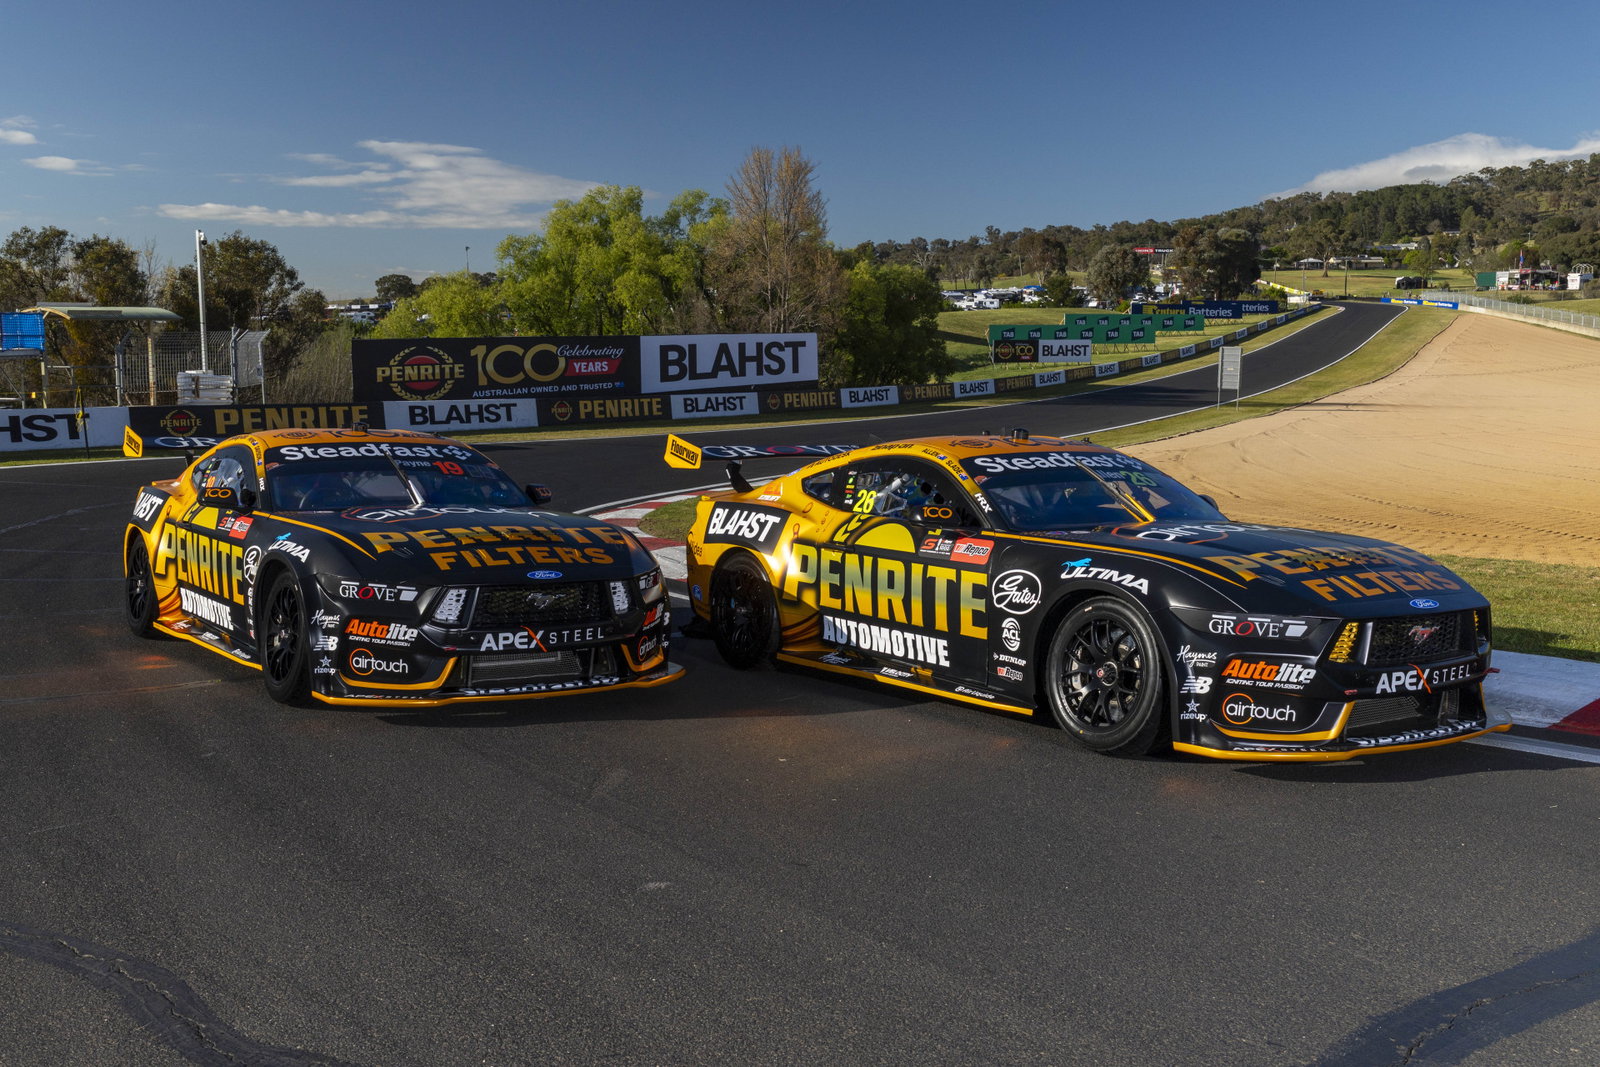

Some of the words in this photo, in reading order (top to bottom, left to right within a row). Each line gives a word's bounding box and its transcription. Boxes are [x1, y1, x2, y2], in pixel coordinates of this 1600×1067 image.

[1188, 306, 1232, 316] Batteries
[556, 344, 625, 359] Celebrating
[1015, 346, 1034, 356] 100
[1042, 345, 1089, 356] BLAHST
[470, 343, 566, 386] 100
[572, 361, 608, 373] YEARS
[659, 340, 806, 383] BLAHST
[1098, 364, 1116, 374] BLAHST
[376, 364, 465, 382] PENRITE
[1040, 372, 1061, 384] BLAHST
[472, 387, 528, 398] AUSTRALIAN
[530, 385, 560, 393] OWNED
[578, 382, 613, 390] TRUSTED
[914, 384, 952, 399] PENRITE
[960, 382, 989, 394] BLAHST
[1006, 376, 1033, 389] PENRITE
[784, 392, 836, 408] PENRITE
[849, 388, 890, 403] BLAHST
[408, 402, 517, 425] BLAHST
[579, 398, 662, 419] PENRITE
[683, 396, 746, 414] BLAHST
[0, 413, 90, 442] HST
[160, 418, 202, 427] PENRITE
[214, 406, 368, 434] PENRITE
[280, 444, 444, 461] Steadfast
[671, 439, 699, 464] Floorway
[922, 448, 940, 458] ALLEN
[396, 460, 432, 468] Payne
[433, 461, 464, 475] 19
[945, 460, 964, 475] SLADE
[974, 452, 1124, 473] Steadfast
[1096, 470, 1126, 480] llen
[1120, 470, 1158, 486] 26
[205, 488, 232, 498] 100
[853, 490, 877, 513] 26
[974, 493, 993, 513] HRX
[923, 507, 953, 519] 100
[708, 507, 781, 542] BLAHST
[360, 526, 628, 553] PENRITE
[430, 545, 614, 570] FILTERS
[964, 543, 989, 555] Repco
[155, 522, 244, 606] PENRITE
[1202, 546, 1443, 582] PENRITE
[1060, 564, 1149, 596] ULTIMA
[1300, 571, 1461, 602] FILTERS
[339, 584, 395, 602] GROVE
[782, 543, 988, 640] PENRITE
[998, 575, 1040, 605] Gates
[180, 587, 234, 631] AUTOMOTIVE
[344, 618, 418, 642] Autolite
[1002, 629, 1021, 641] ACL
[1209, 618, 1280, 638] GROVE
[480, 626, 548, 652] APEX
[549, 627, 605, 644] STEEL
[822, 614, 950, 667] AUTOMOTIVE
[352, 655, 408, 674] airtouch
[999, 654, 1027, 666] DUNLOP
[1177, 645, 1217, 667] Haymes
[1005, 667, 1024, 681] Repco
[1221, 658, 1317, 684] Autolite
[1376, 663, 1432, 694] APEX
[1432, 664, 1471, 684] STEEL
[1180, 713, 1206, 722] rizeup
[1226, 702, 1296, 722] airtouch
